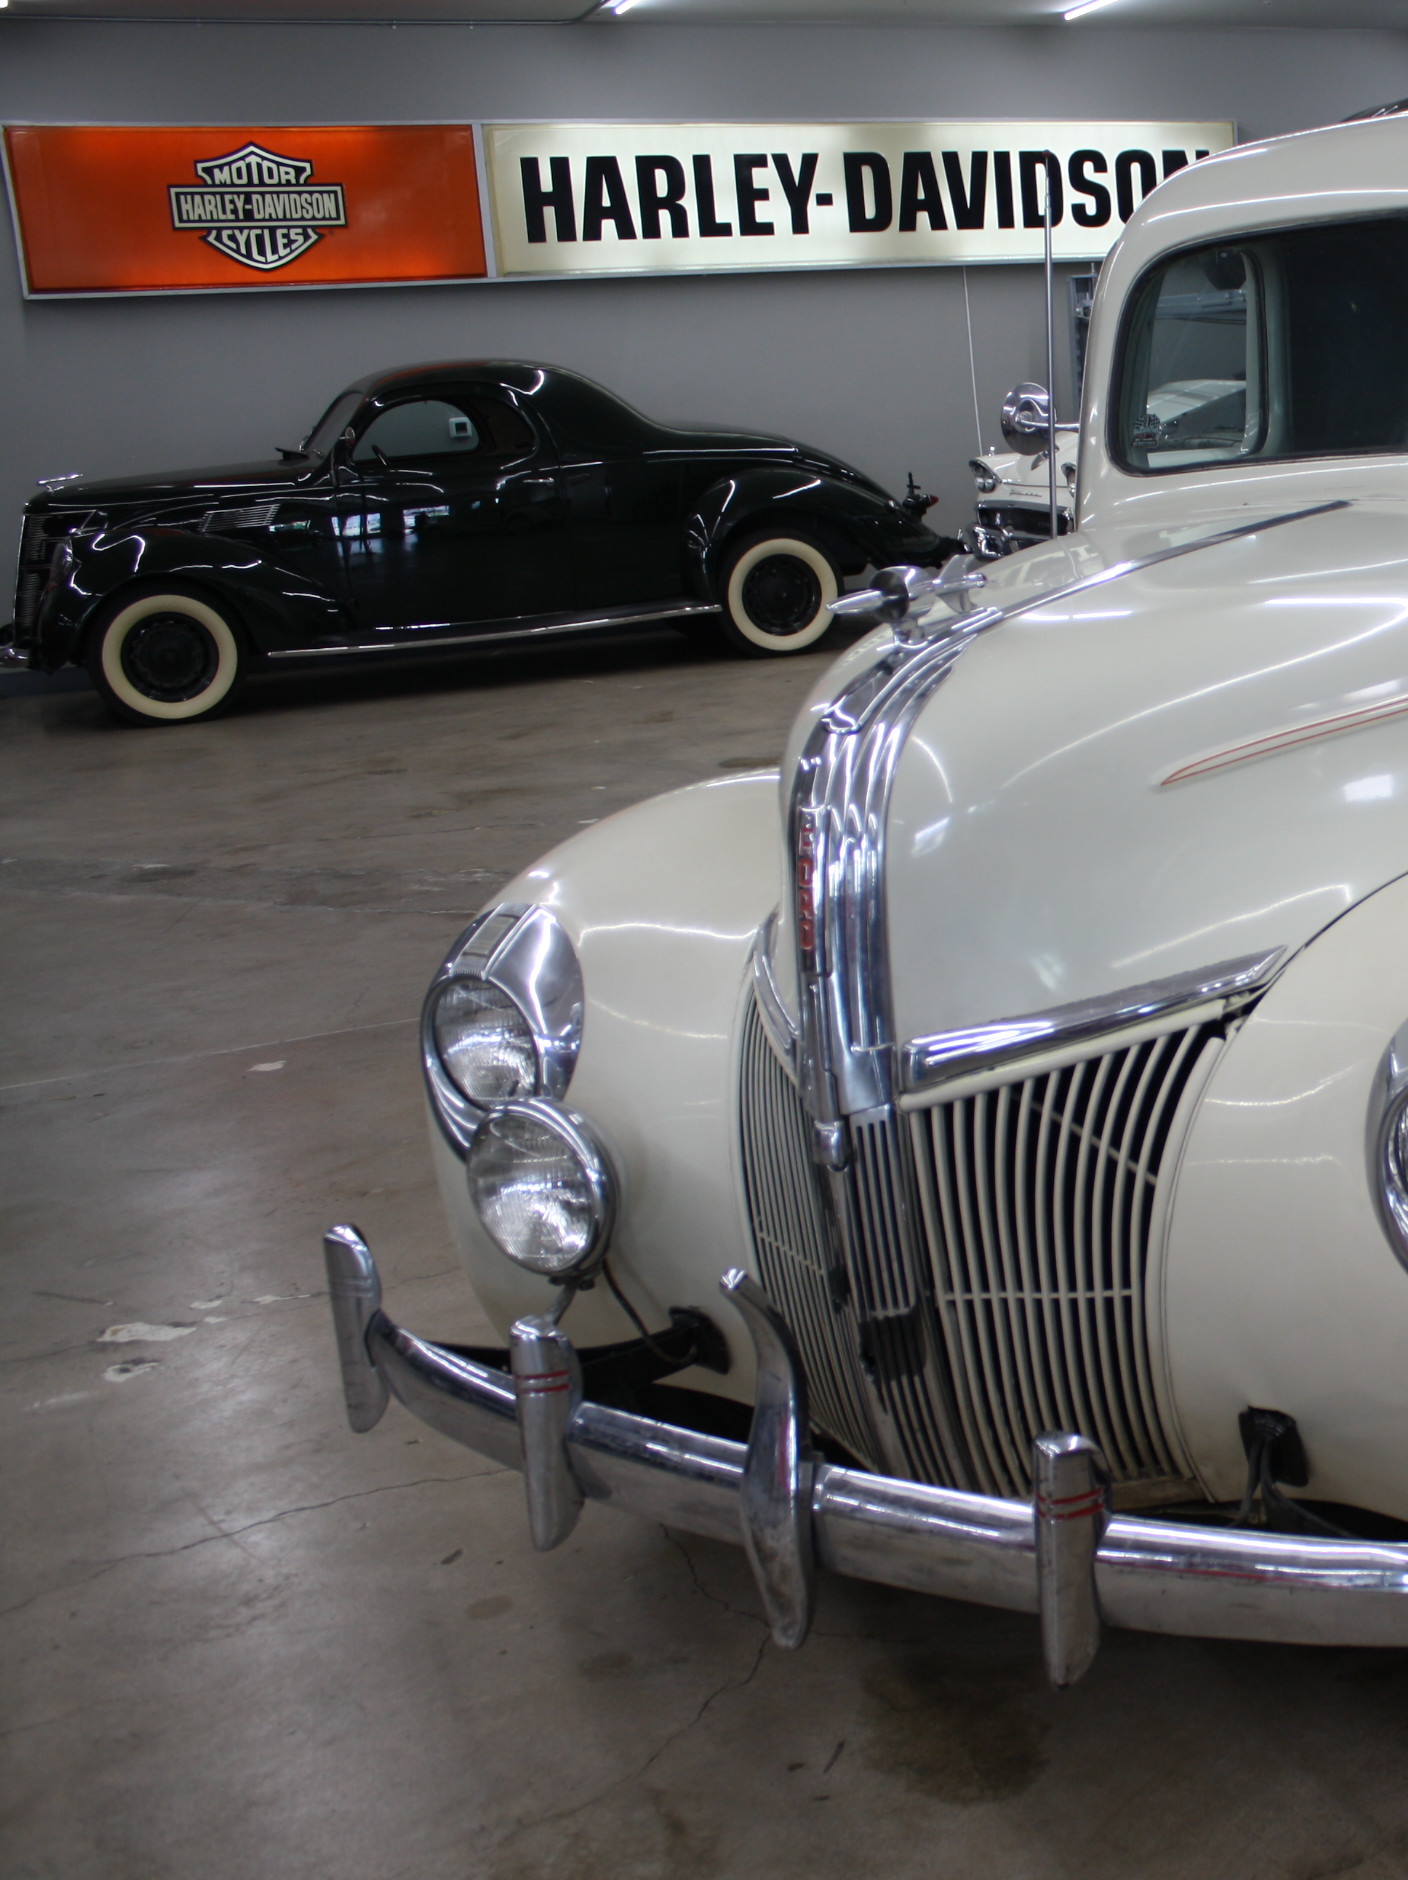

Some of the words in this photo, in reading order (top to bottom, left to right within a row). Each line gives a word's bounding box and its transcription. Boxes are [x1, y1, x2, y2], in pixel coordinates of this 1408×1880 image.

[213, 154, 296, 185] MOTOR
[180, 193, 338, 221] HARLEY-DAVIDSON
[221, 228, 305, 263] CYCLES
